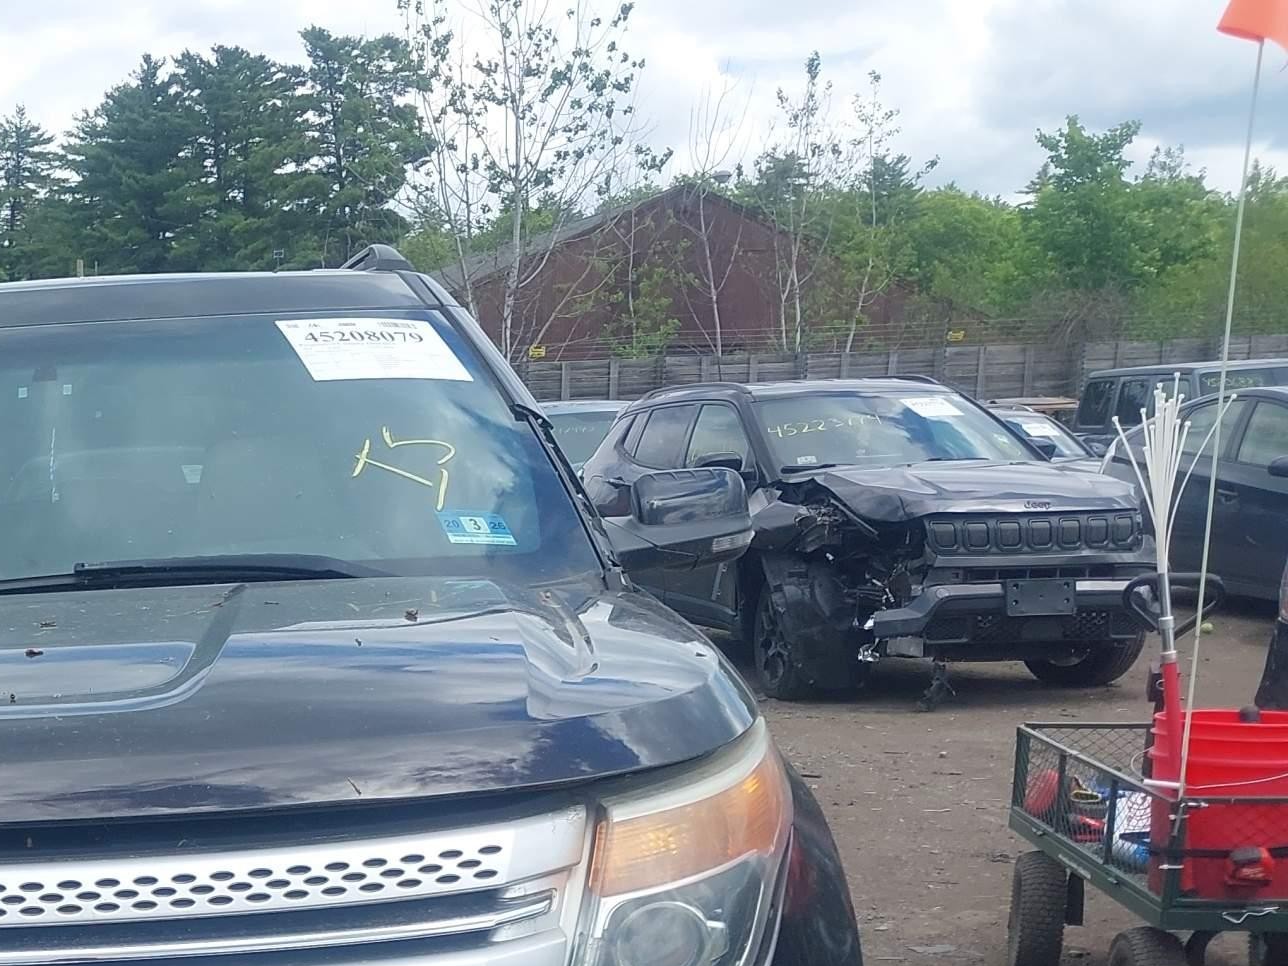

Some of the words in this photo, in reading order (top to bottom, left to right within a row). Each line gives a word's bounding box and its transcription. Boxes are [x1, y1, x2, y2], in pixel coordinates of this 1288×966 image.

[304, 330, 424, 344] 45208079
[443, 519, 460, 529] 20
[469, 518, 481, 531] 3
